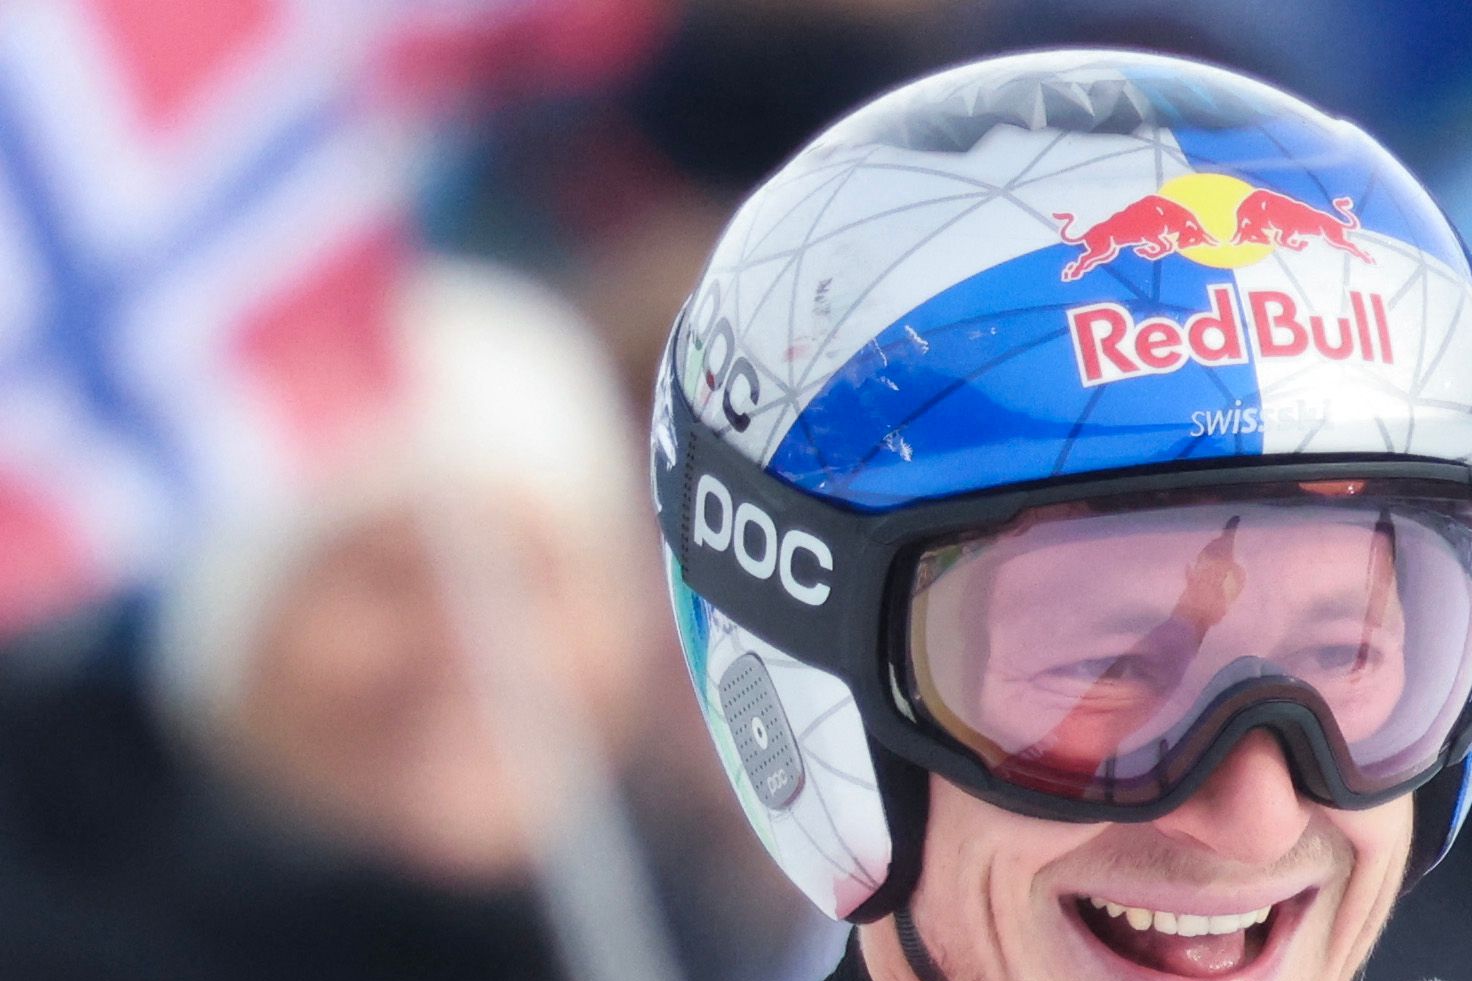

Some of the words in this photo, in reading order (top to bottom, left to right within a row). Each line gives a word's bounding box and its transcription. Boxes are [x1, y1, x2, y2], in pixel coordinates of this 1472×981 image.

[1071, 287, 1243, 383] Red
[1248, 290, 1394, 366] Bull
[693, 473, 834, 606] poc
